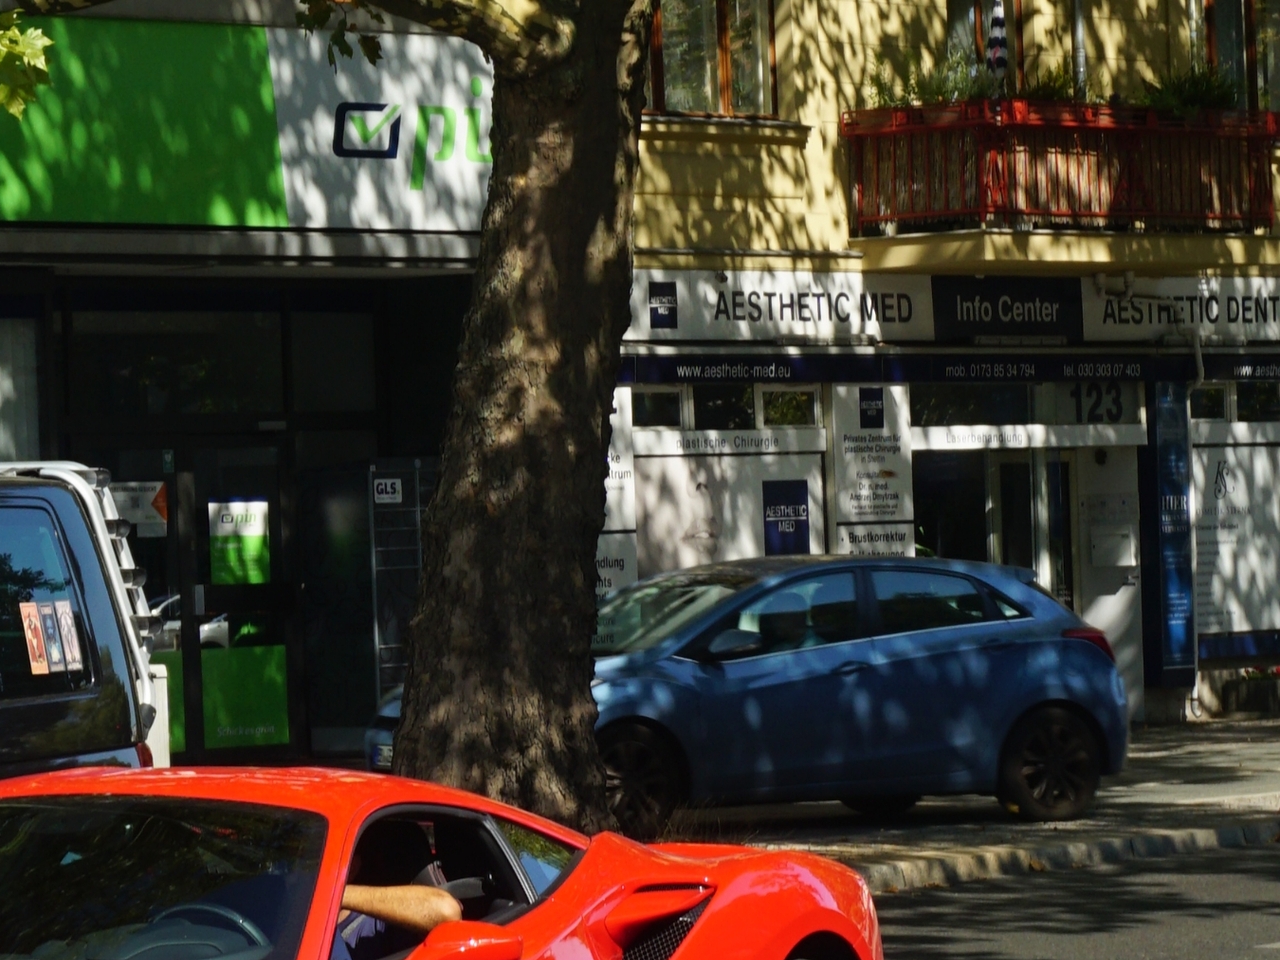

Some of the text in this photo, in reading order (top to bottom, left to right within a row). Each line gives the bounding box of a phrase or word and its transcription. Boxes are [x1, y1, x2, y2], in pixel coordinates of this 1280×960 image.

[714, 291, 913, 323] AESTHETIC MED
[956, 295, 1060, 323] Info Center
[1102, 295, 1280, 325] AESTHETIC DENT
[676, 363, 791, 379] www.aesthetic-med.eu
[945, 363, 1035, 377] mob. 0173 85 34 794
[1063, 363, 1141, 377] tel. 030 303 07 403
[1070, 381, 1124, 424] 123
[675, 435, 780, 450] plastische Chirurgie
[945, 431, 1024, 446] Laserbehandlung
[609, 469, 632, 480] trum
[234, 508, 257, 527] pin
[765, 503, 808, 517] AESTHETIC
[778, 520, 796, 533] MED
[848, 531, 907, 544] Brustkorrektur
